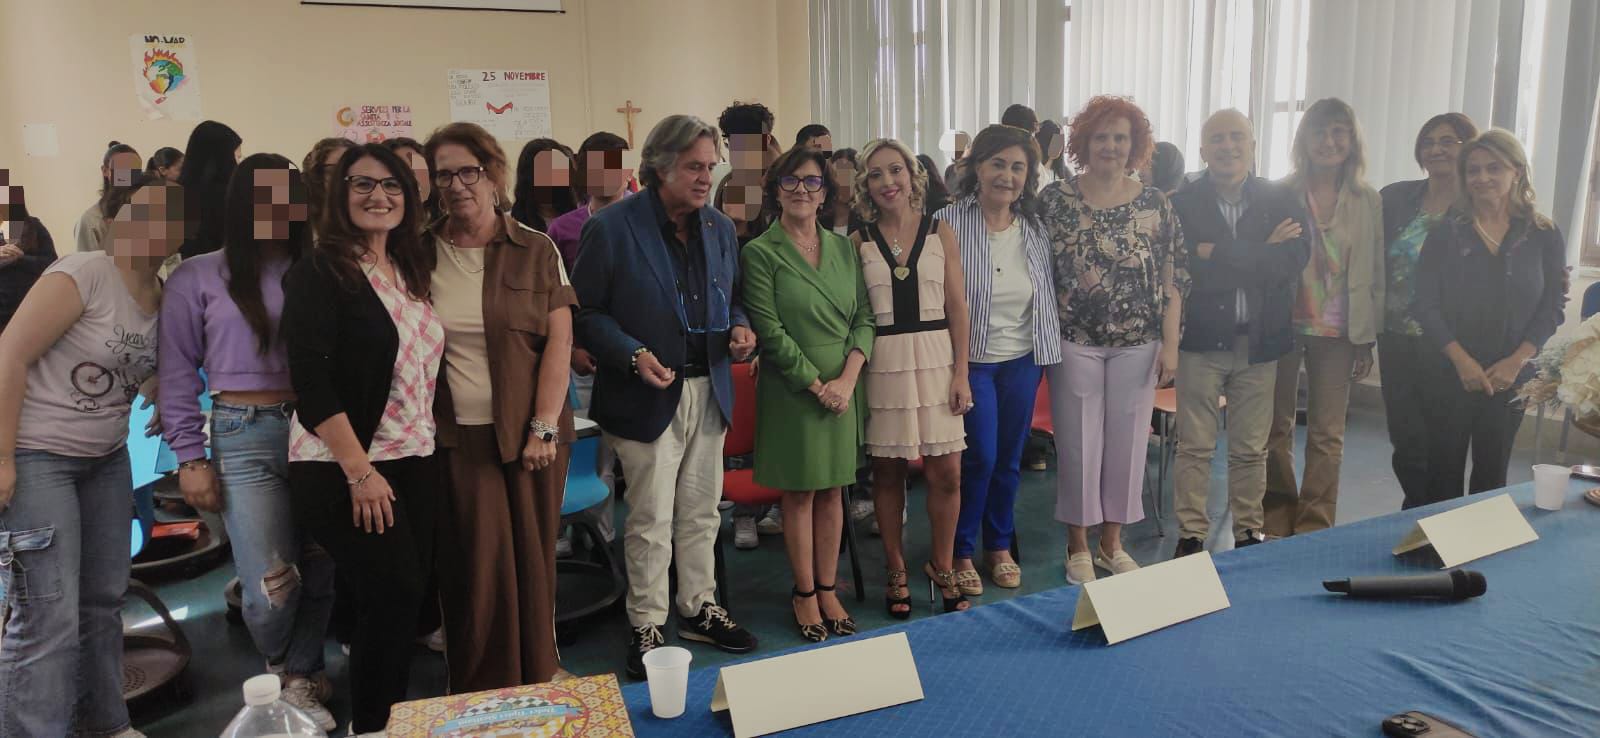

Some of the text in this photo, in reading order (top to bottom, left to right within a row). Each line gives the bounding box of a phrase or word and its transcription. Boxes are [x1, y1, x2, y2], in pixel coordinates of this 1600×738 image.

[482, 71, 546, 82] 25 NOVEMBRE
[391, 105, 402, 113] PER
[402, 105, 411, 113] LA
